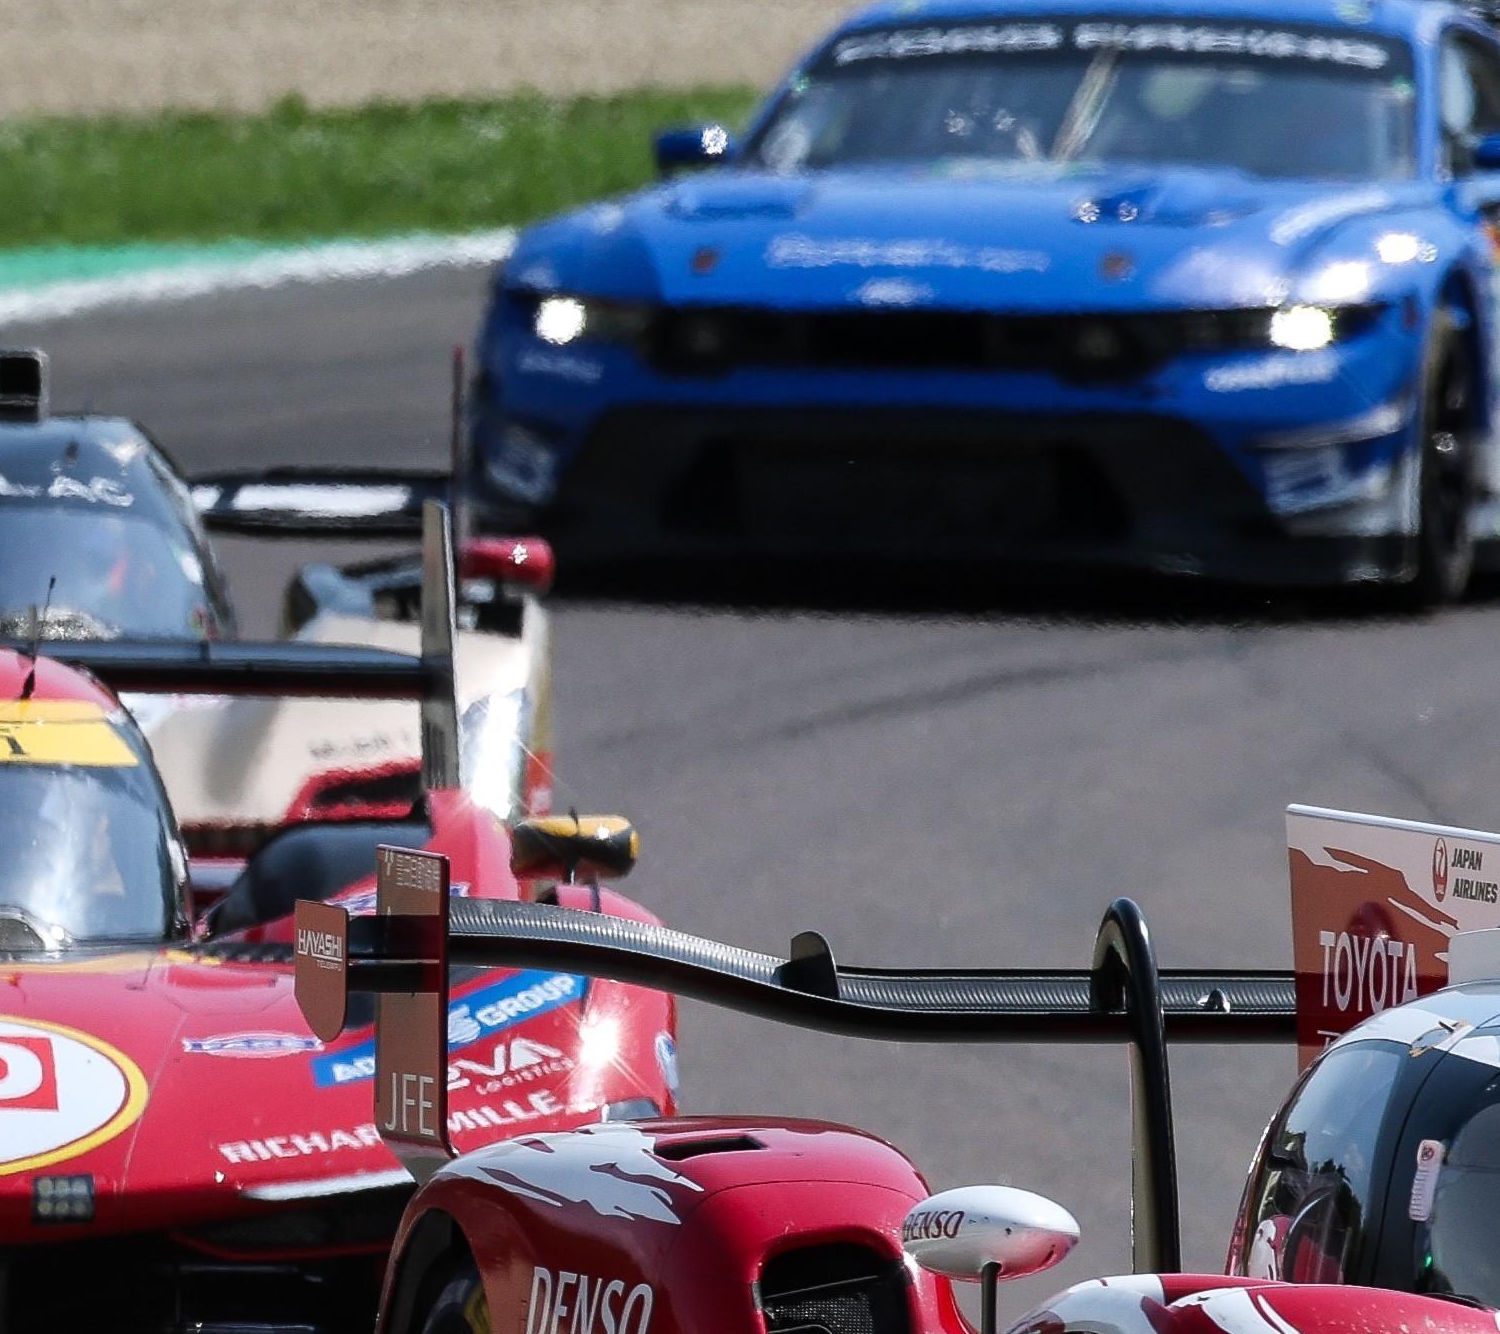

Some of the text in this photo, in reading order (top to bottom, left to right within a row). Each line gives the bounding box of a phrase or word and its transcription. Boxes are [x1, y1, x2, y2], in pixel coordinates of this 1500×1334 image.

[1451, 848, 1482, 871] JAPAN
[1452, 877, 1498, 904] AIRLINES
[298, 929, 342, 959] HAYASHI
[1319, 930, 1418, 1016] TOYOTA
[476, 975, 576, 1026] GROUP
[385, 1072, 435, 1136] JFE
[219, 1122, 380, 1164] RICHAR
[902, 1210, 964, 1243] DENSO
